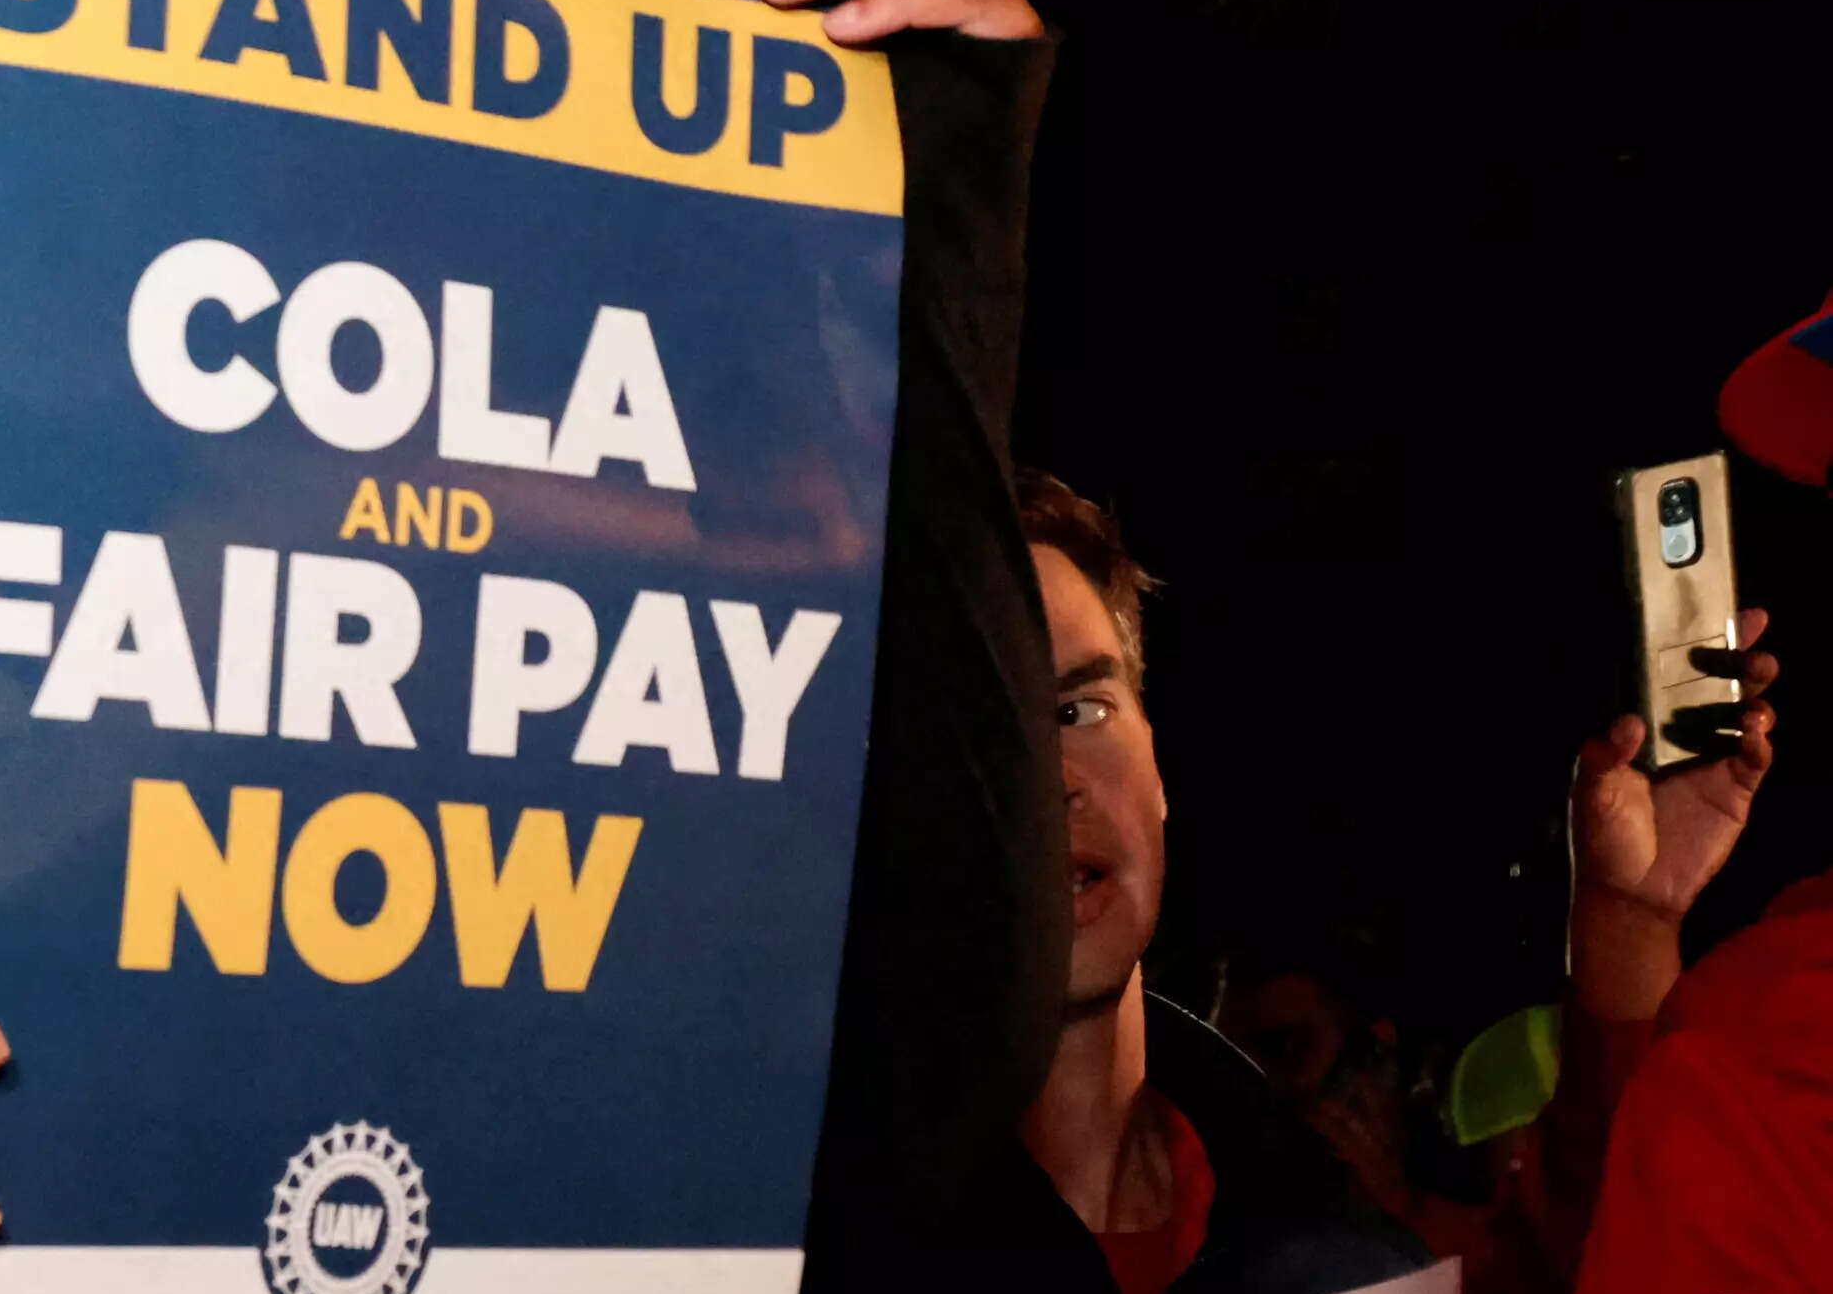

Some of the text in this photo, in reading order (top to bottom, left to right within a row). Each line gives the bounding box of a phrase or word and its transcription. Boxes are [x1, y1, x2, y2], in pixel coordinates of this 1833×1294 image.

[629, 11, 847, 169] UP
[127, 238, 698, 493] COLA
[340, 478, 493, 554] AND
[467, 573, 843, 782] PAY
[118, 779, 644, 993] NOW
[312, 1201, 385, 1250] UAW
